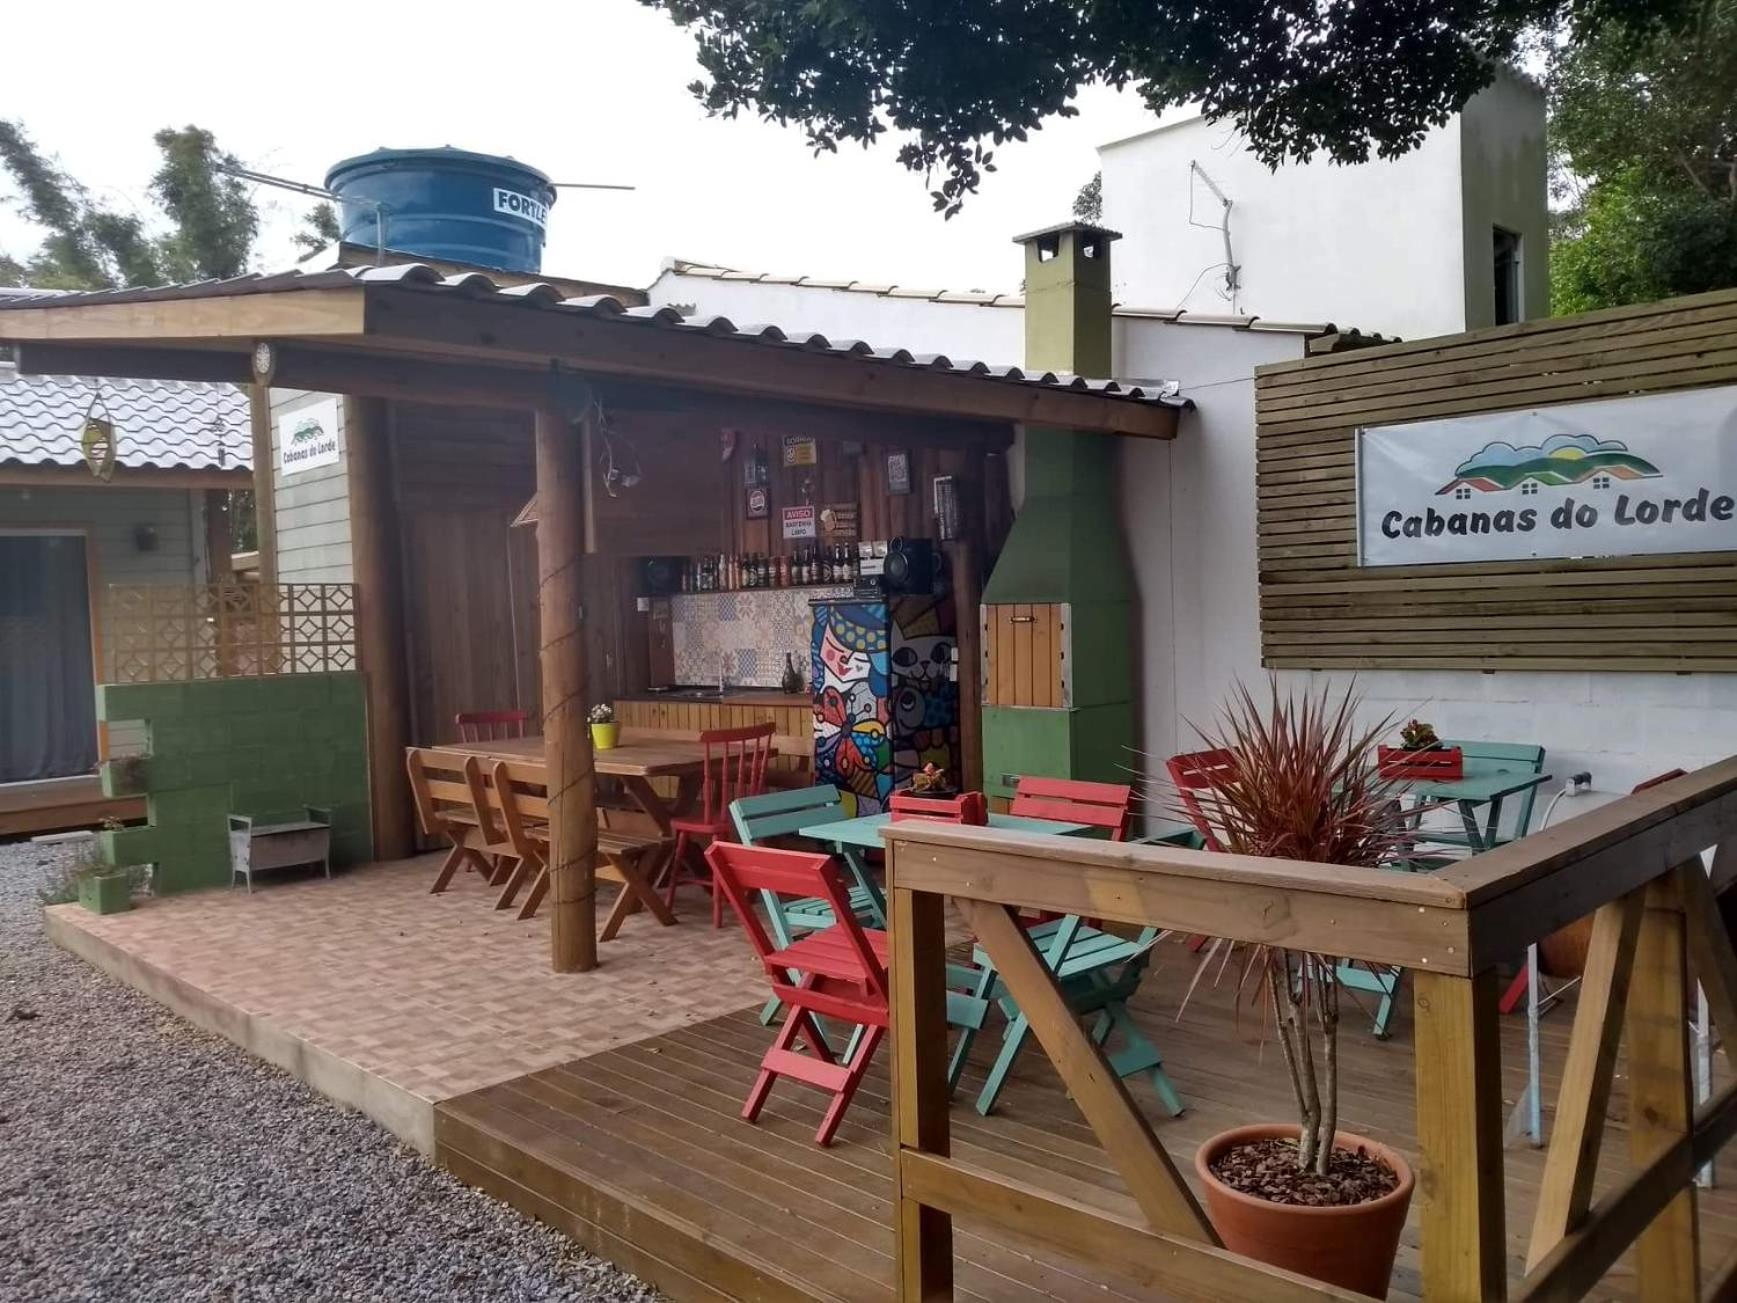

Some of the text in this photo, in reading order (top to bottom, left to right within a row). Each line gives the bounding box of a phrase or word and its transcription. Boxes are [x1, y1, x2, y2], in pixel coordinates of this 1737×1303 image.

[283, 438, 336, 464] Cabanas do Lorde
[786, 510, 811, 520] AVISO
[1381, 487, 1736, 540] Cabanas do Lorde
